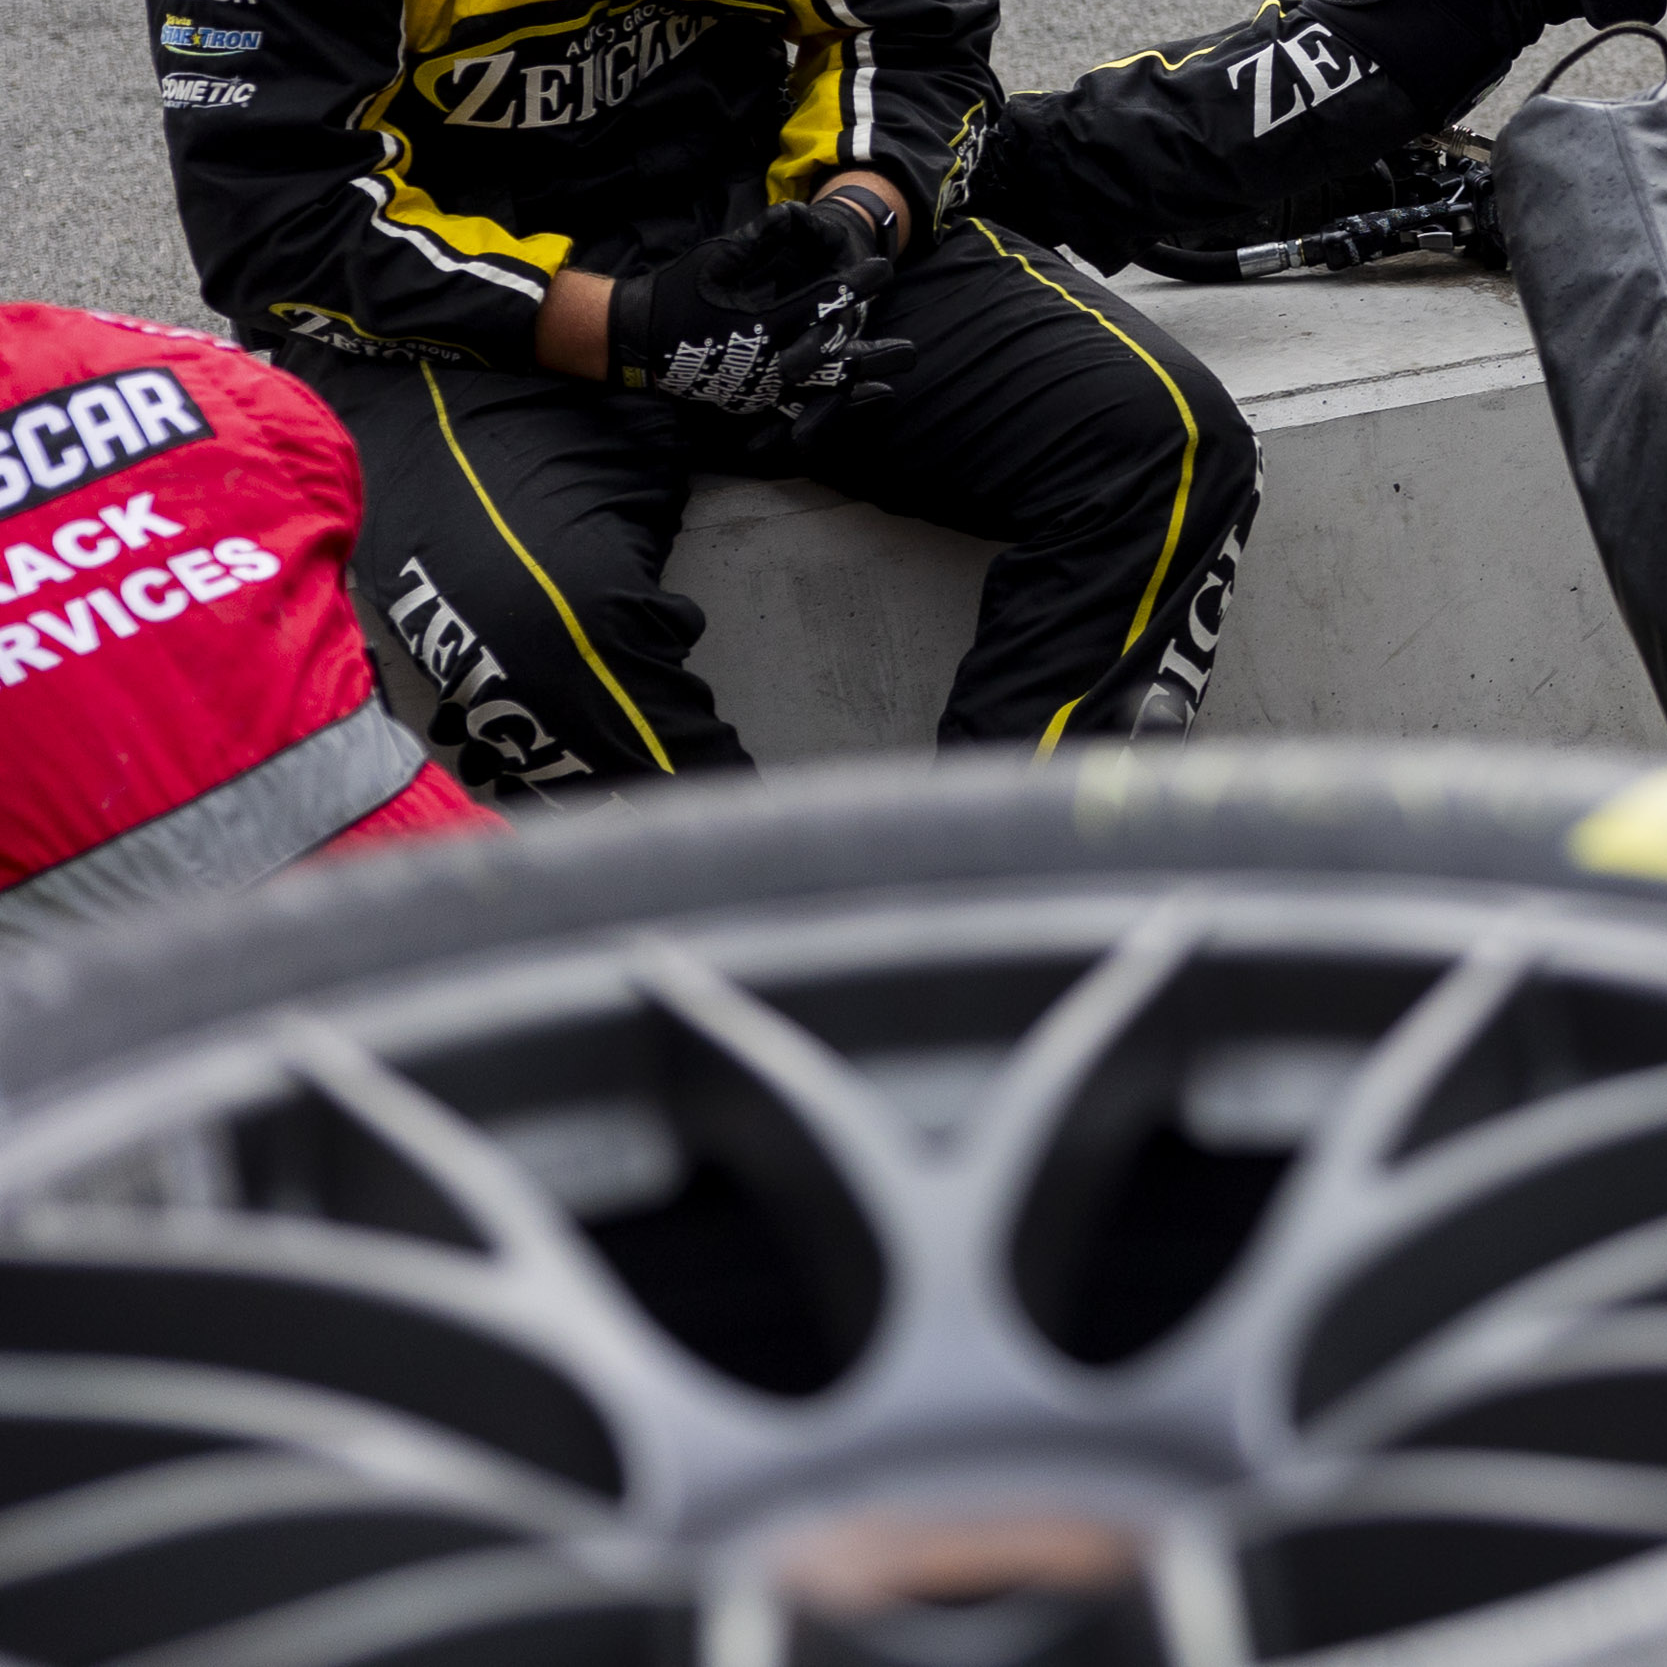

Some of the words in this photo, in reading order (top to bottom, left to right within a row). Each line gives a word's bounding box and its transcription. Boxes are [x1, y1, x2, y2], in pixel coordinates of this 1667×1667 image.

[162, 78, 256, 104] COMETIC
[1227, 23, 1380, 138] ZE
[0, 491, 187, 604] ACK
[388, 556, 610, 814] ZEIGL
